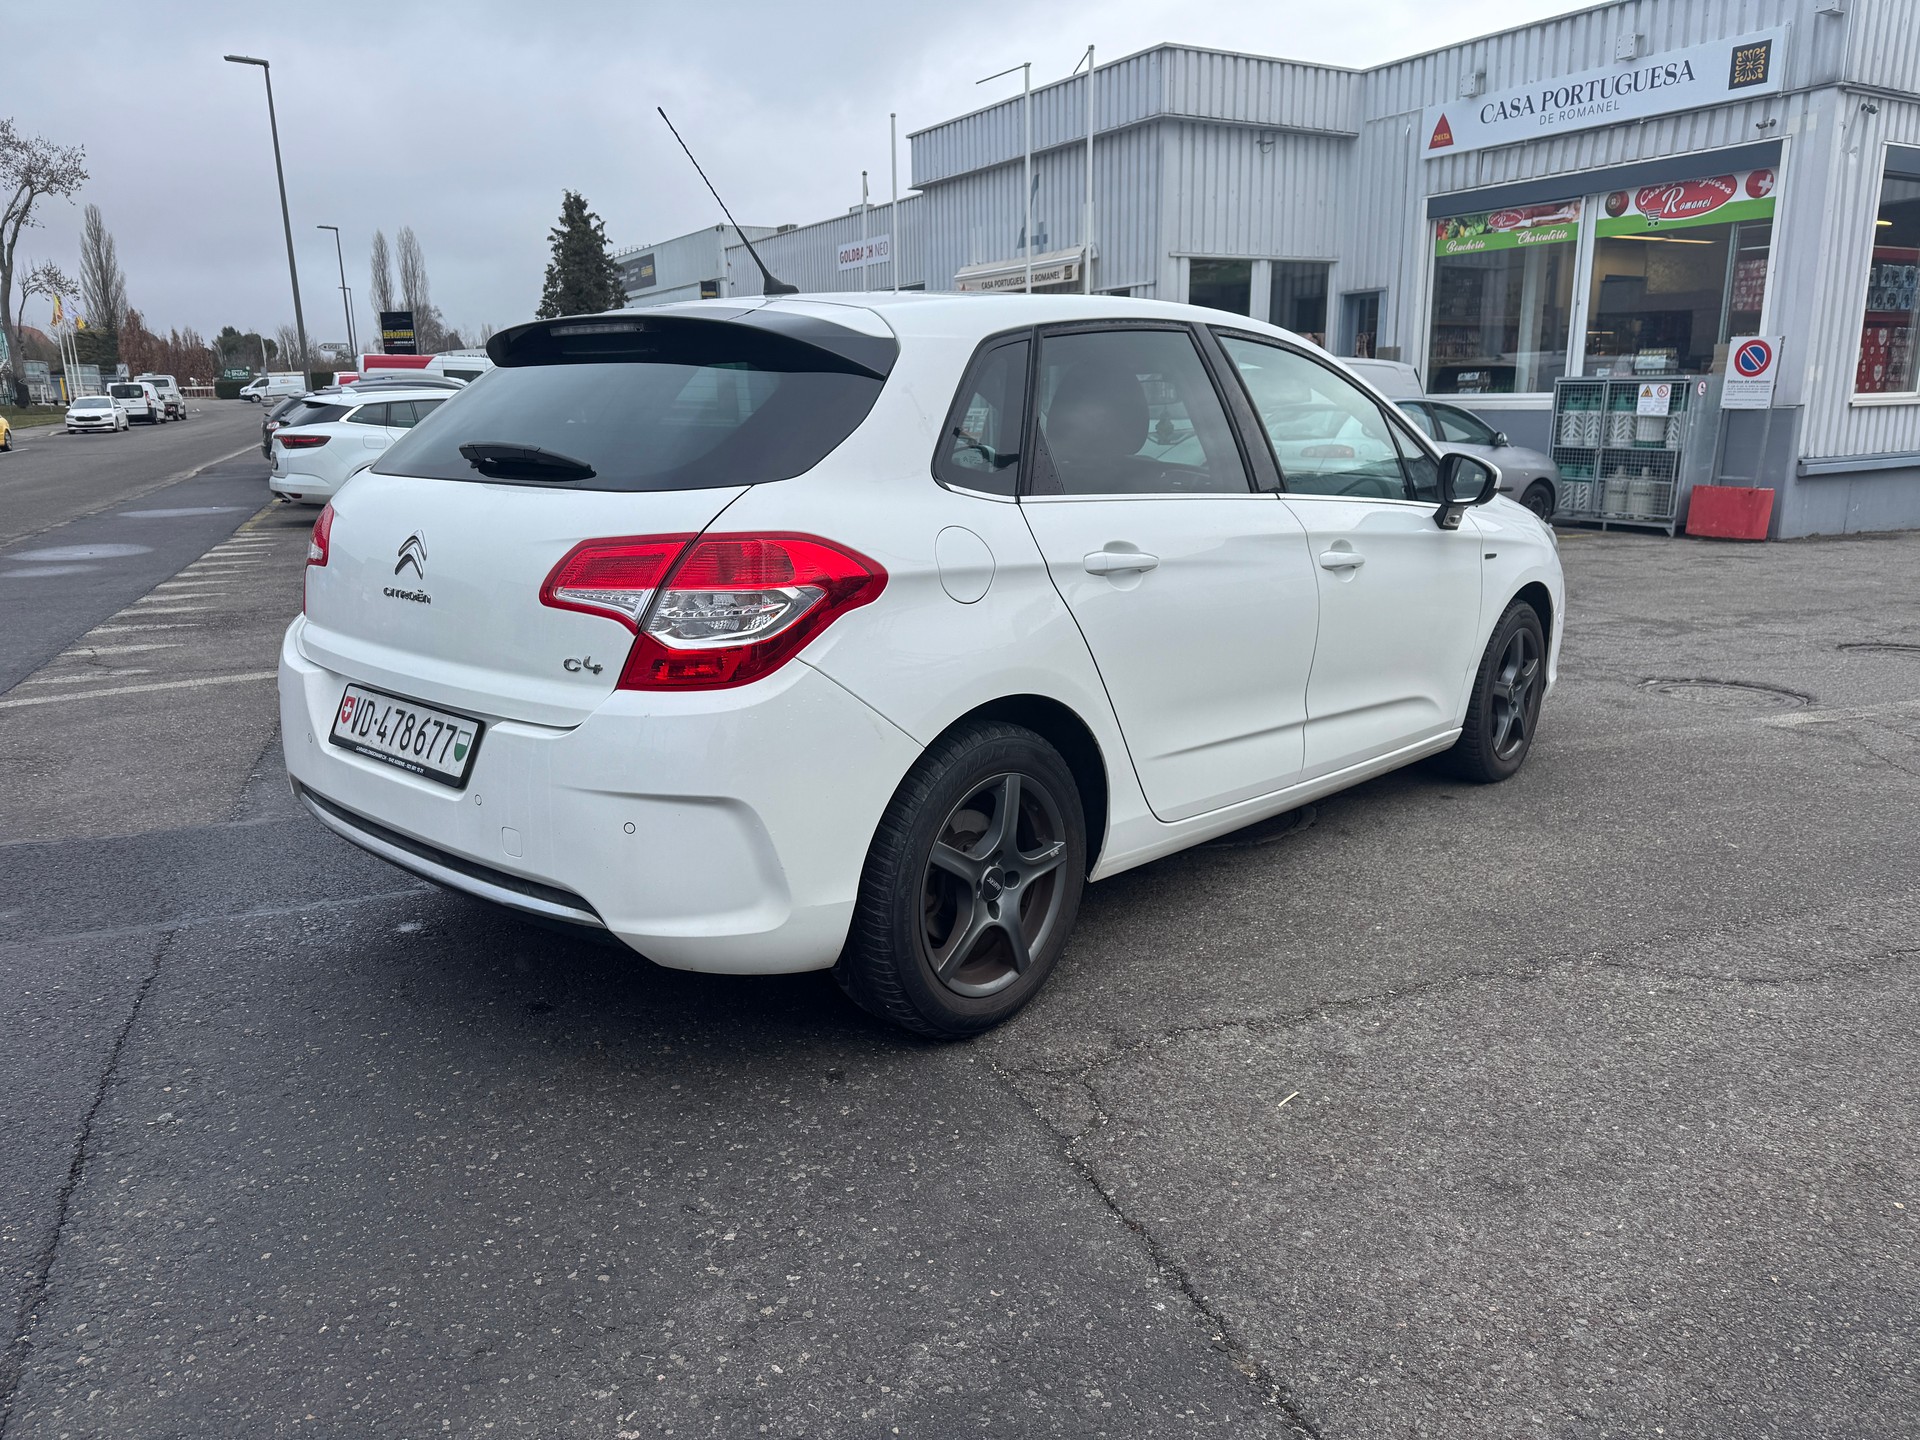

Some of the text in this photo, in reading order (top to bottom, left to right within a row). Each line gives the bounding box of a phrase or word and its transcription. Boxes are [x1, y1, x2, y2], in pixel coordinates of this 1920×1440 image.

[1480, 60, 1695, 124] CASA PORTUGUESA
[1540, 100, 1620, 125] DE ROMANEL
[1434, 133, 1450, 142] DELTA
[1661, 186, 1713, 214] Romanel
[1516, 229, 1568, 244] Charcuterie
[840, 241, 889, 264] GOLDBAH NEO
[1446, 240, 1485, 254] Boucherie
[982, 280, 994, 290] CASA
[994, 276, 1026, 288] PORTUGUESA
[1034, 271, 1060, 282] ROMANEL
[563, 655, 603, 675] C4
